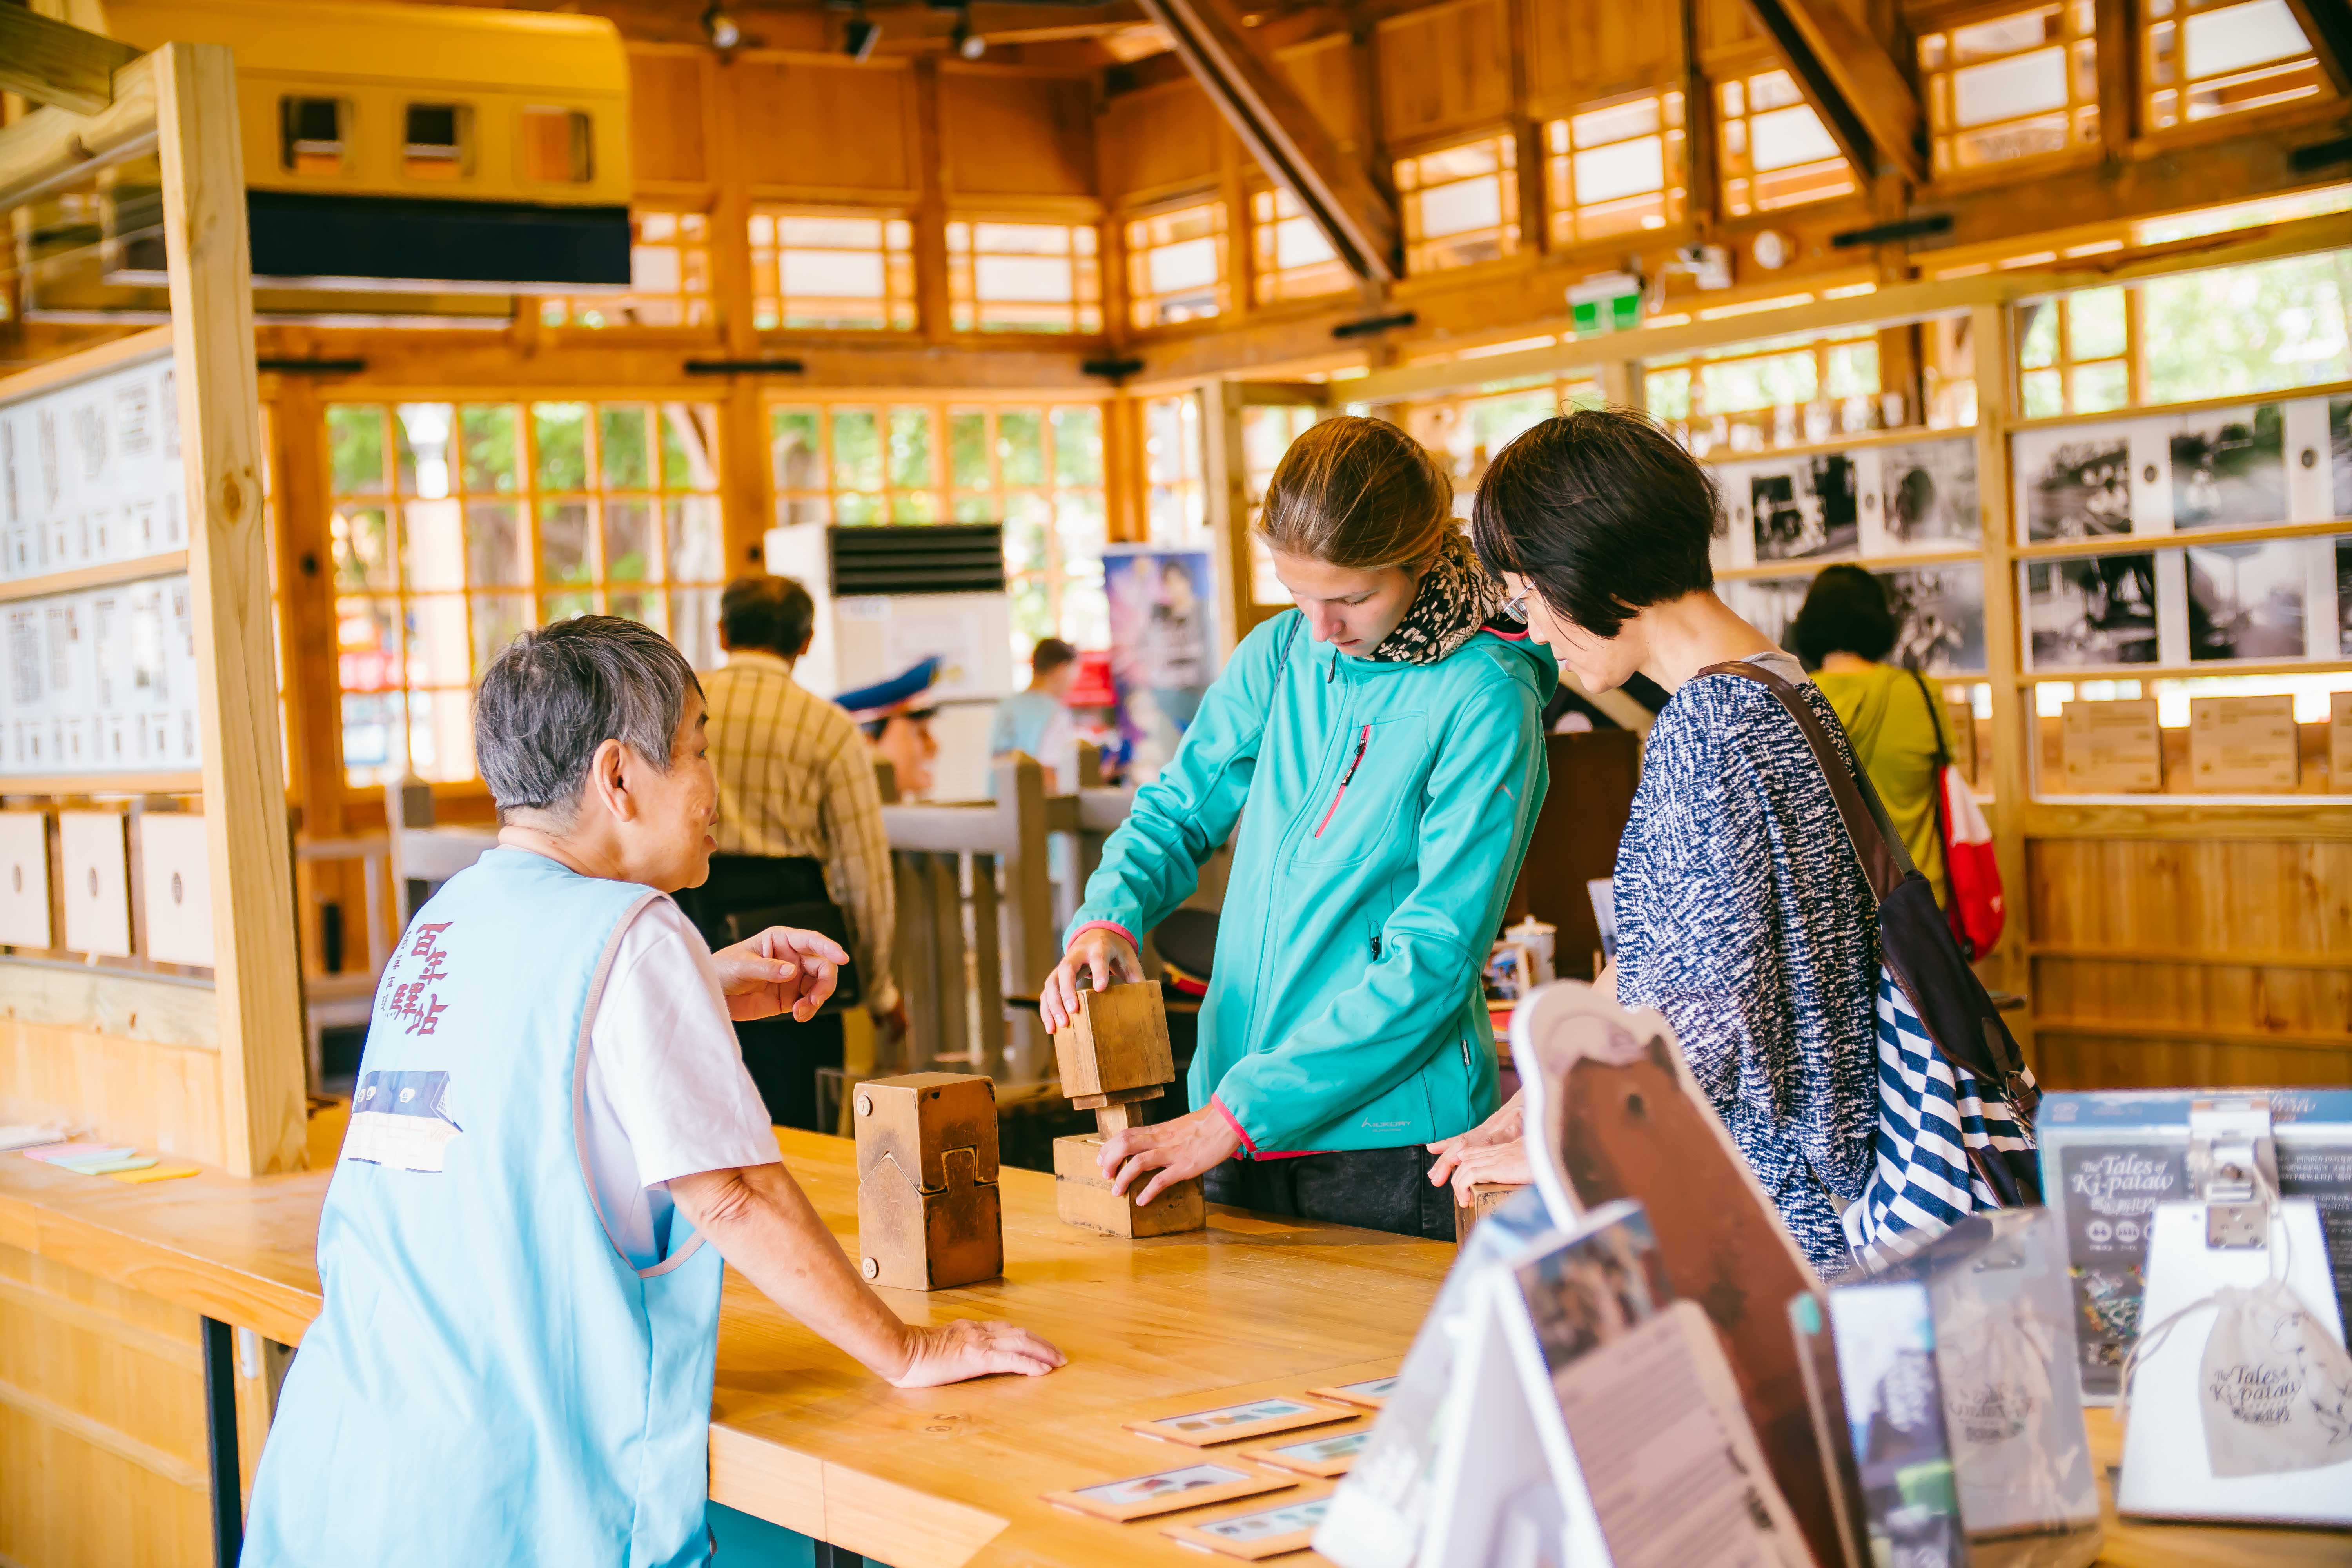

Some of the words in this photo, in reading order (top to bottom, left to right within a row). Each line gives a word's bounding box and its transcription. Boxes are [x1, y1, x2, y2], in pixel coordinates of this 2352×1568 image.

[2100, 1154, 2153, 1174] Tales
[2154, 1160, 2168, 1174] of
[2215, 1370, 2232, 1381] The
[2231, 1364, 2280, 1384] Tales
